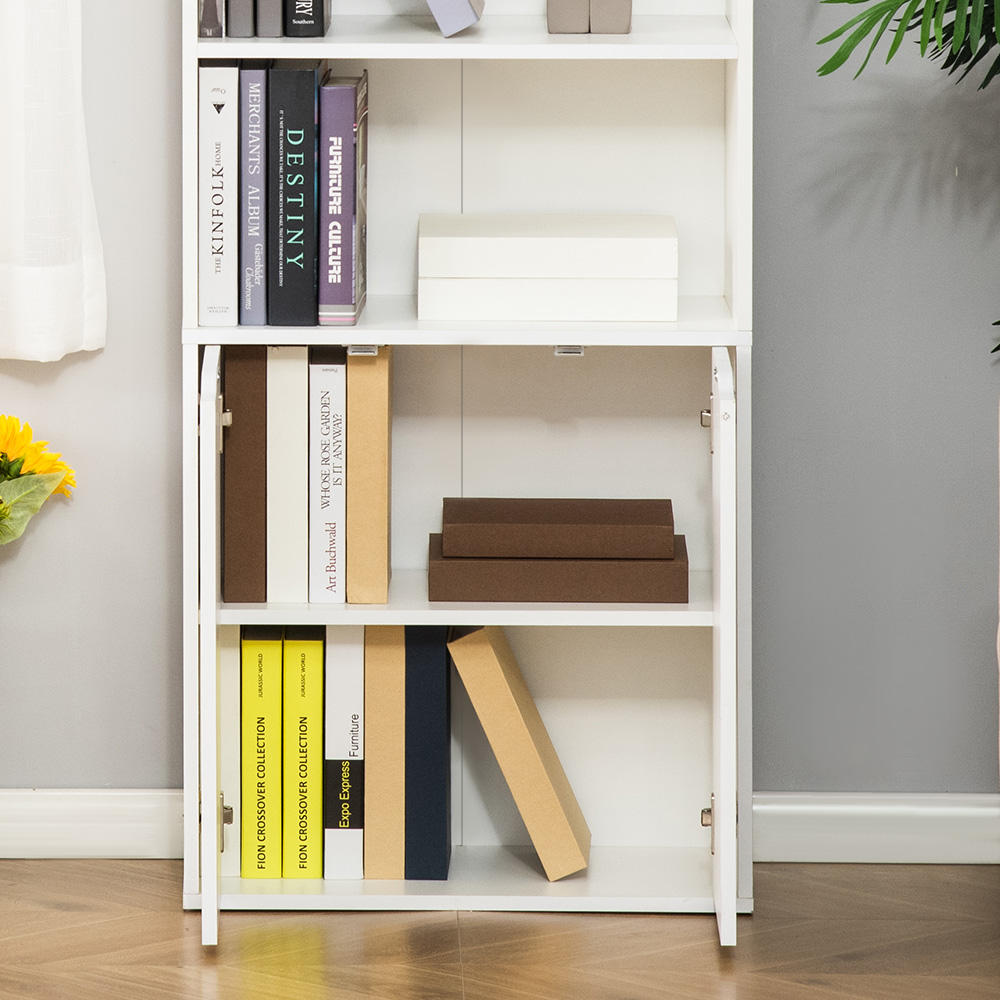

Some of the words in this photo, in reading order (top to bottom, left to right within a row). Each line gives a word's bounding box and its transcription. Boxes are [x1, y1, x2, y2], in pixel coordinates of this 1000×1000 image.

[249, 83, 260, 174] MERCHANTS
[214, 142, 222, 166] HOME
[329, 137, 342, 214] FURNITURE
[212, 166, 224, 256] KINFOLK
[248, 185, 260, 236] ALBUM
[287, 129, 304, 269] DESTINY
[328, 221, 341, 283] CULTURE
[245, 267, 254, 310] Cloakrooms
[321, 391, 330, 436] GARDEN
[321, 440, 330, 465] ROSE
[333, 414, 342, 460] ANYWAY?
[321, 471, 330, 509] WHOSE
[333, 463, 342, 473] IT
[325, 523, 336, 571] Buchwald
[326, 577, 336, 592] Art
[257, 717, 265, 778] COLLECTION
[299, 717, 307, 778] COLLECTION
[349, 714, 359, 757] Furniture
[339, 761, 351, 800] Express
[257, 782, 265, 841] CROSSOVER
[299, 781, 307, 841] CROSSOVER
[339, 803, 351, 827] Expo
[257, 845, 266, 869] FION
[299, 845, 307, 868] FION
